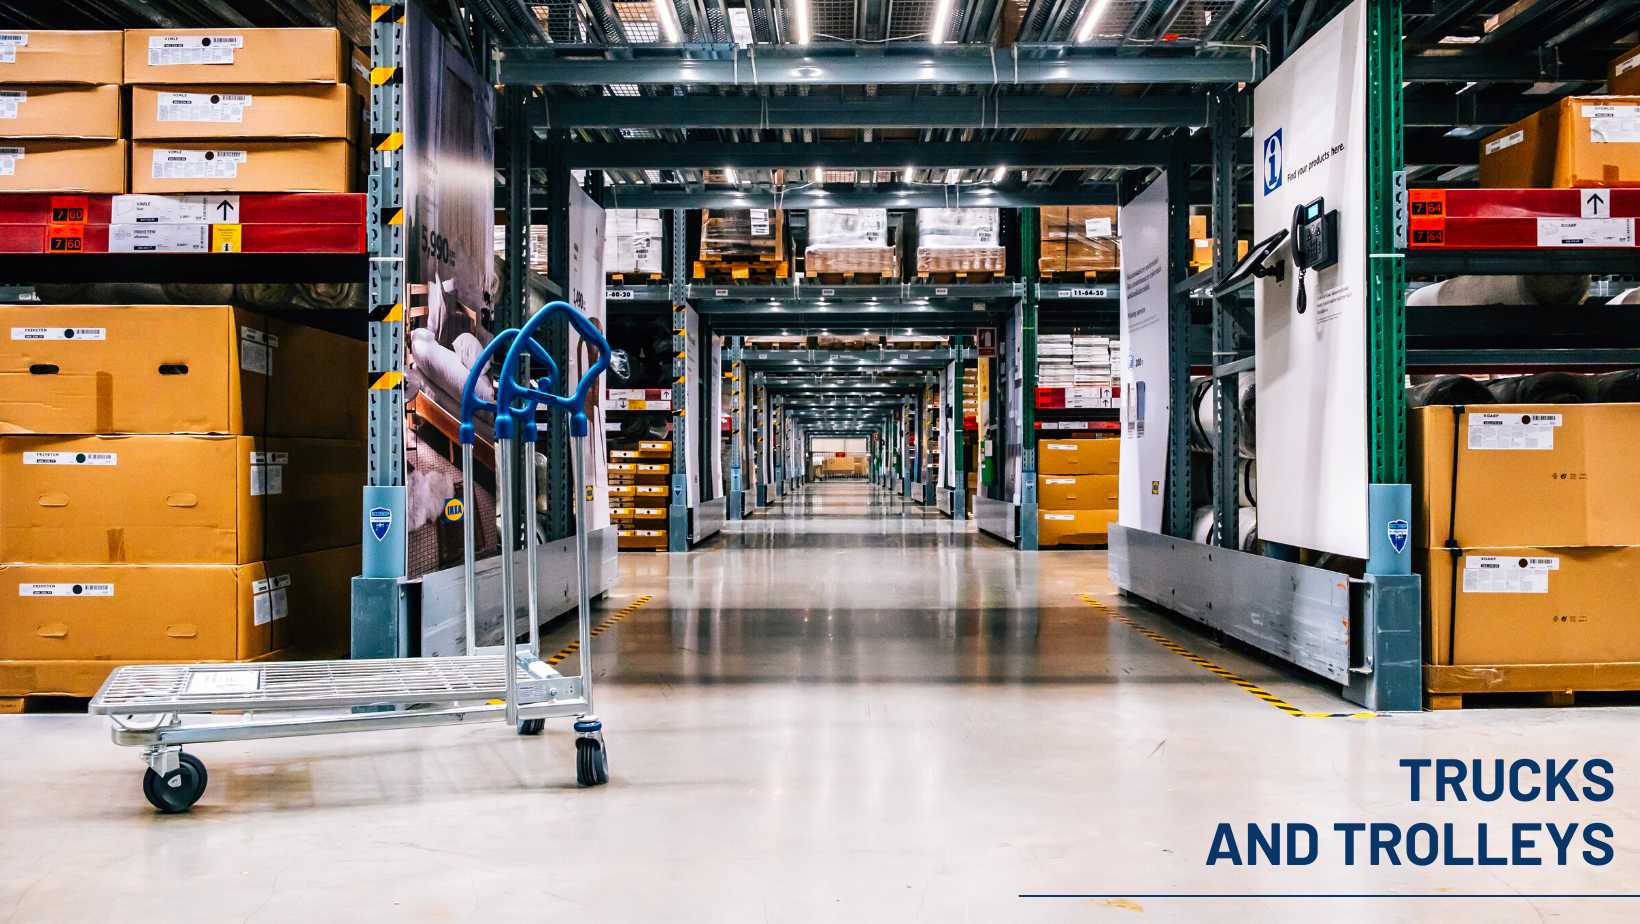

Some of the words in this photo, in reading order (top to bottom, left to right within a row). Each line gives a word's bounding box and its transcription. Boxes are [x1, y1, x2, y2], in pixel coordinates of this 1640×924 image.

[1287, 170, 1297, 182] Find
[1298, 165, 1308, 179] your
[1309, 152, 1330, 172] products
[1331, 143, 1345, 156] here.
[67, 239, 81, 248] 60
[447, 505, 463, 515] IKEA
